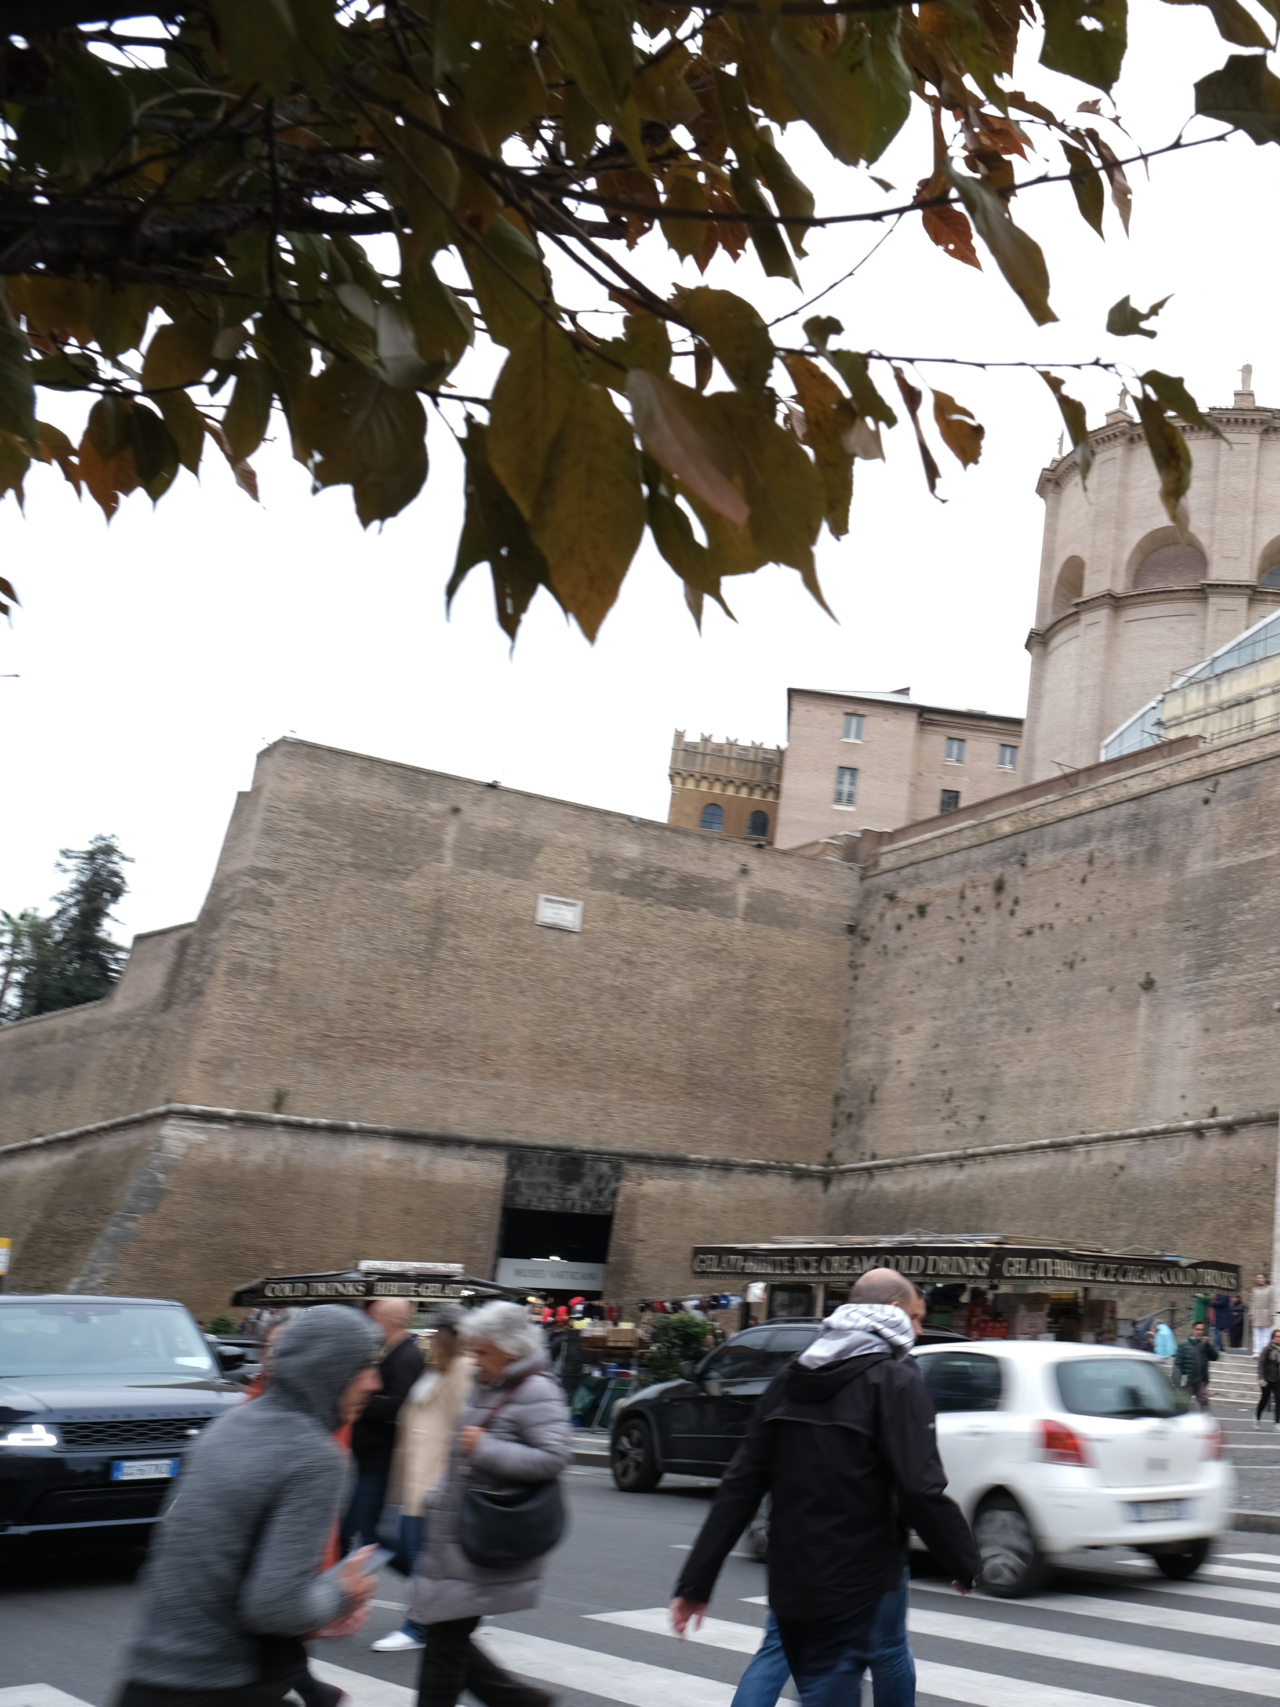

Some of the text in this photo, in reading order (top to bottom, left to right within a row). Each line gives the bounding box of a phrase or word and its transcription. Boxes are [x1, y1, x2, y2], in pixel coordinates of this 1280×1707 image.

[513, 1268, 600, 1281] MUSEI VATICANI
[925, 1256, 991, 1276] DRINKS
[1197, 1268, 1238, 1289] DRINKS
[264, 1282, 367, 1297] COLD DRINKS
